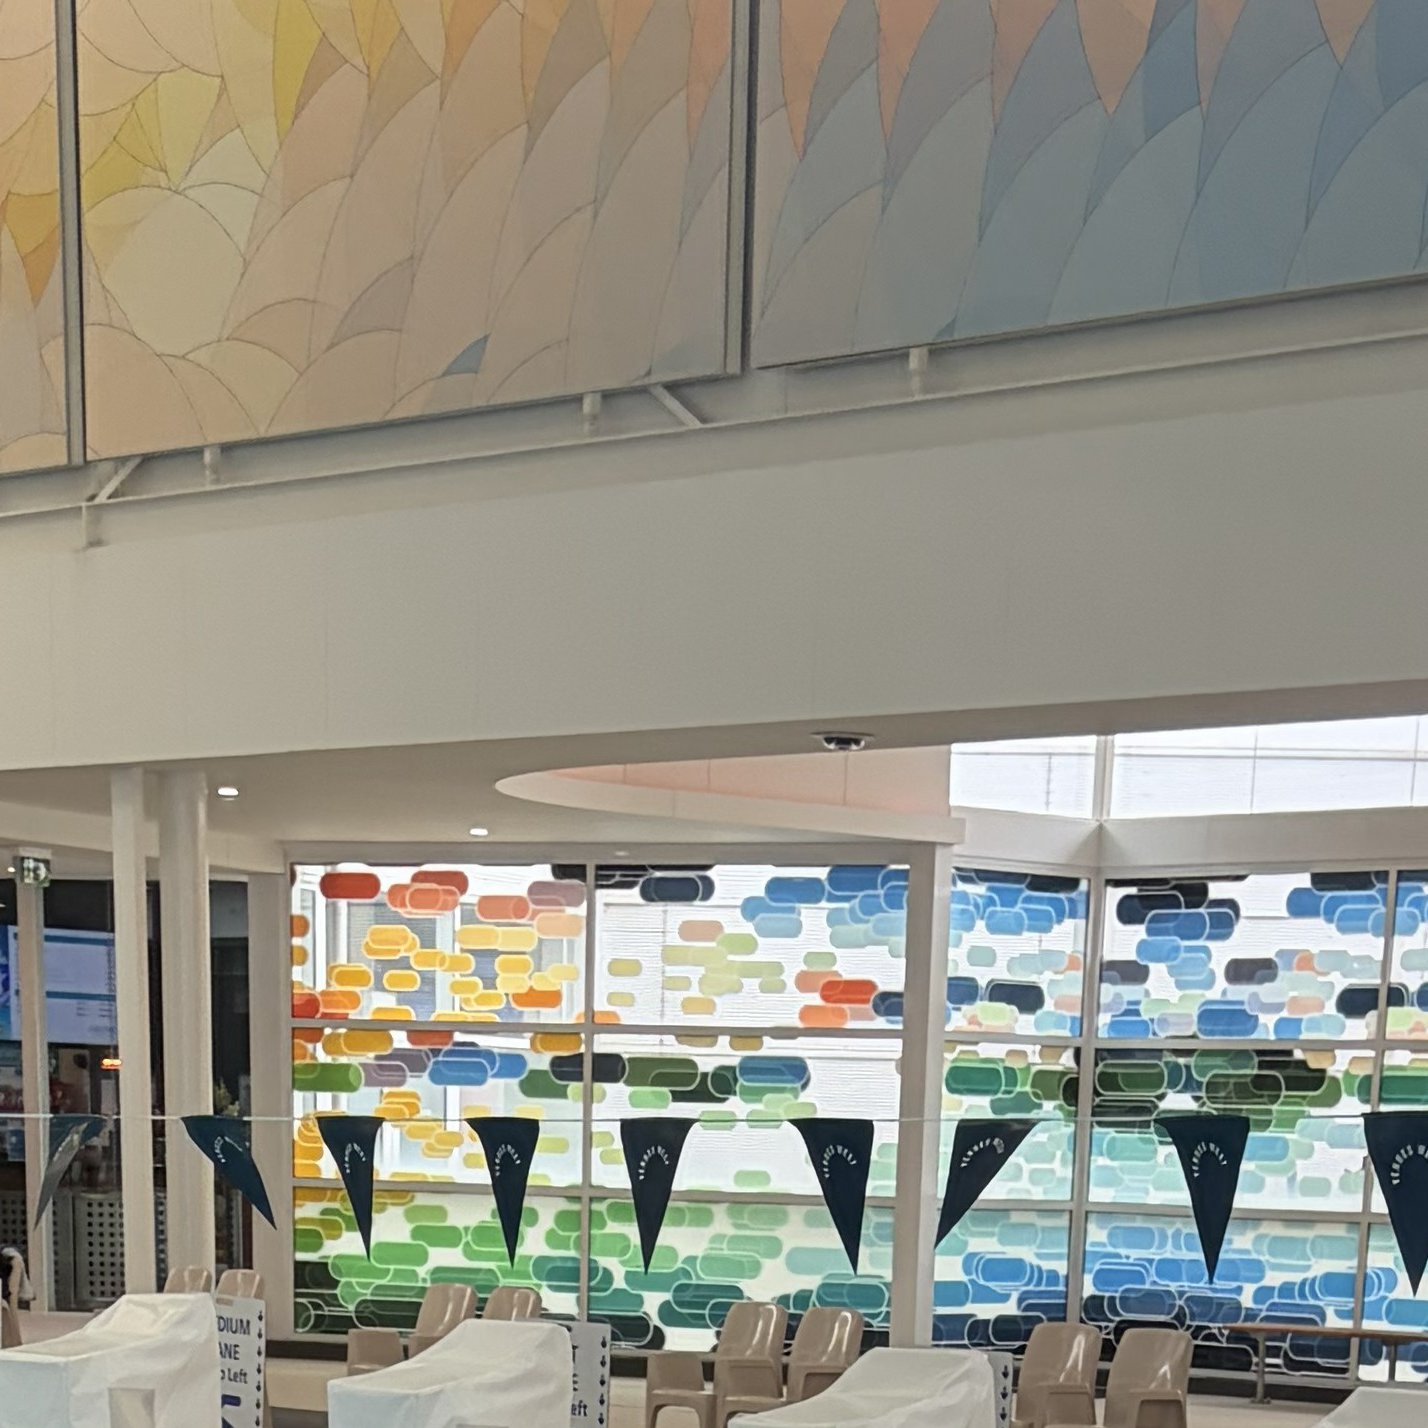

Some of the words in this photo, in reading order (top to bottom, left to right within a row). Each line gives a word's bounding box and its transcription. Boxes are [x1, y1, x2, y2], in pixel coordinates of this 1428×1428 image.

[217, 1315, 251, 1336] DIUM
[227, 1367, 248, 1384] Left
[571, 1400, 588, 1417] eft
